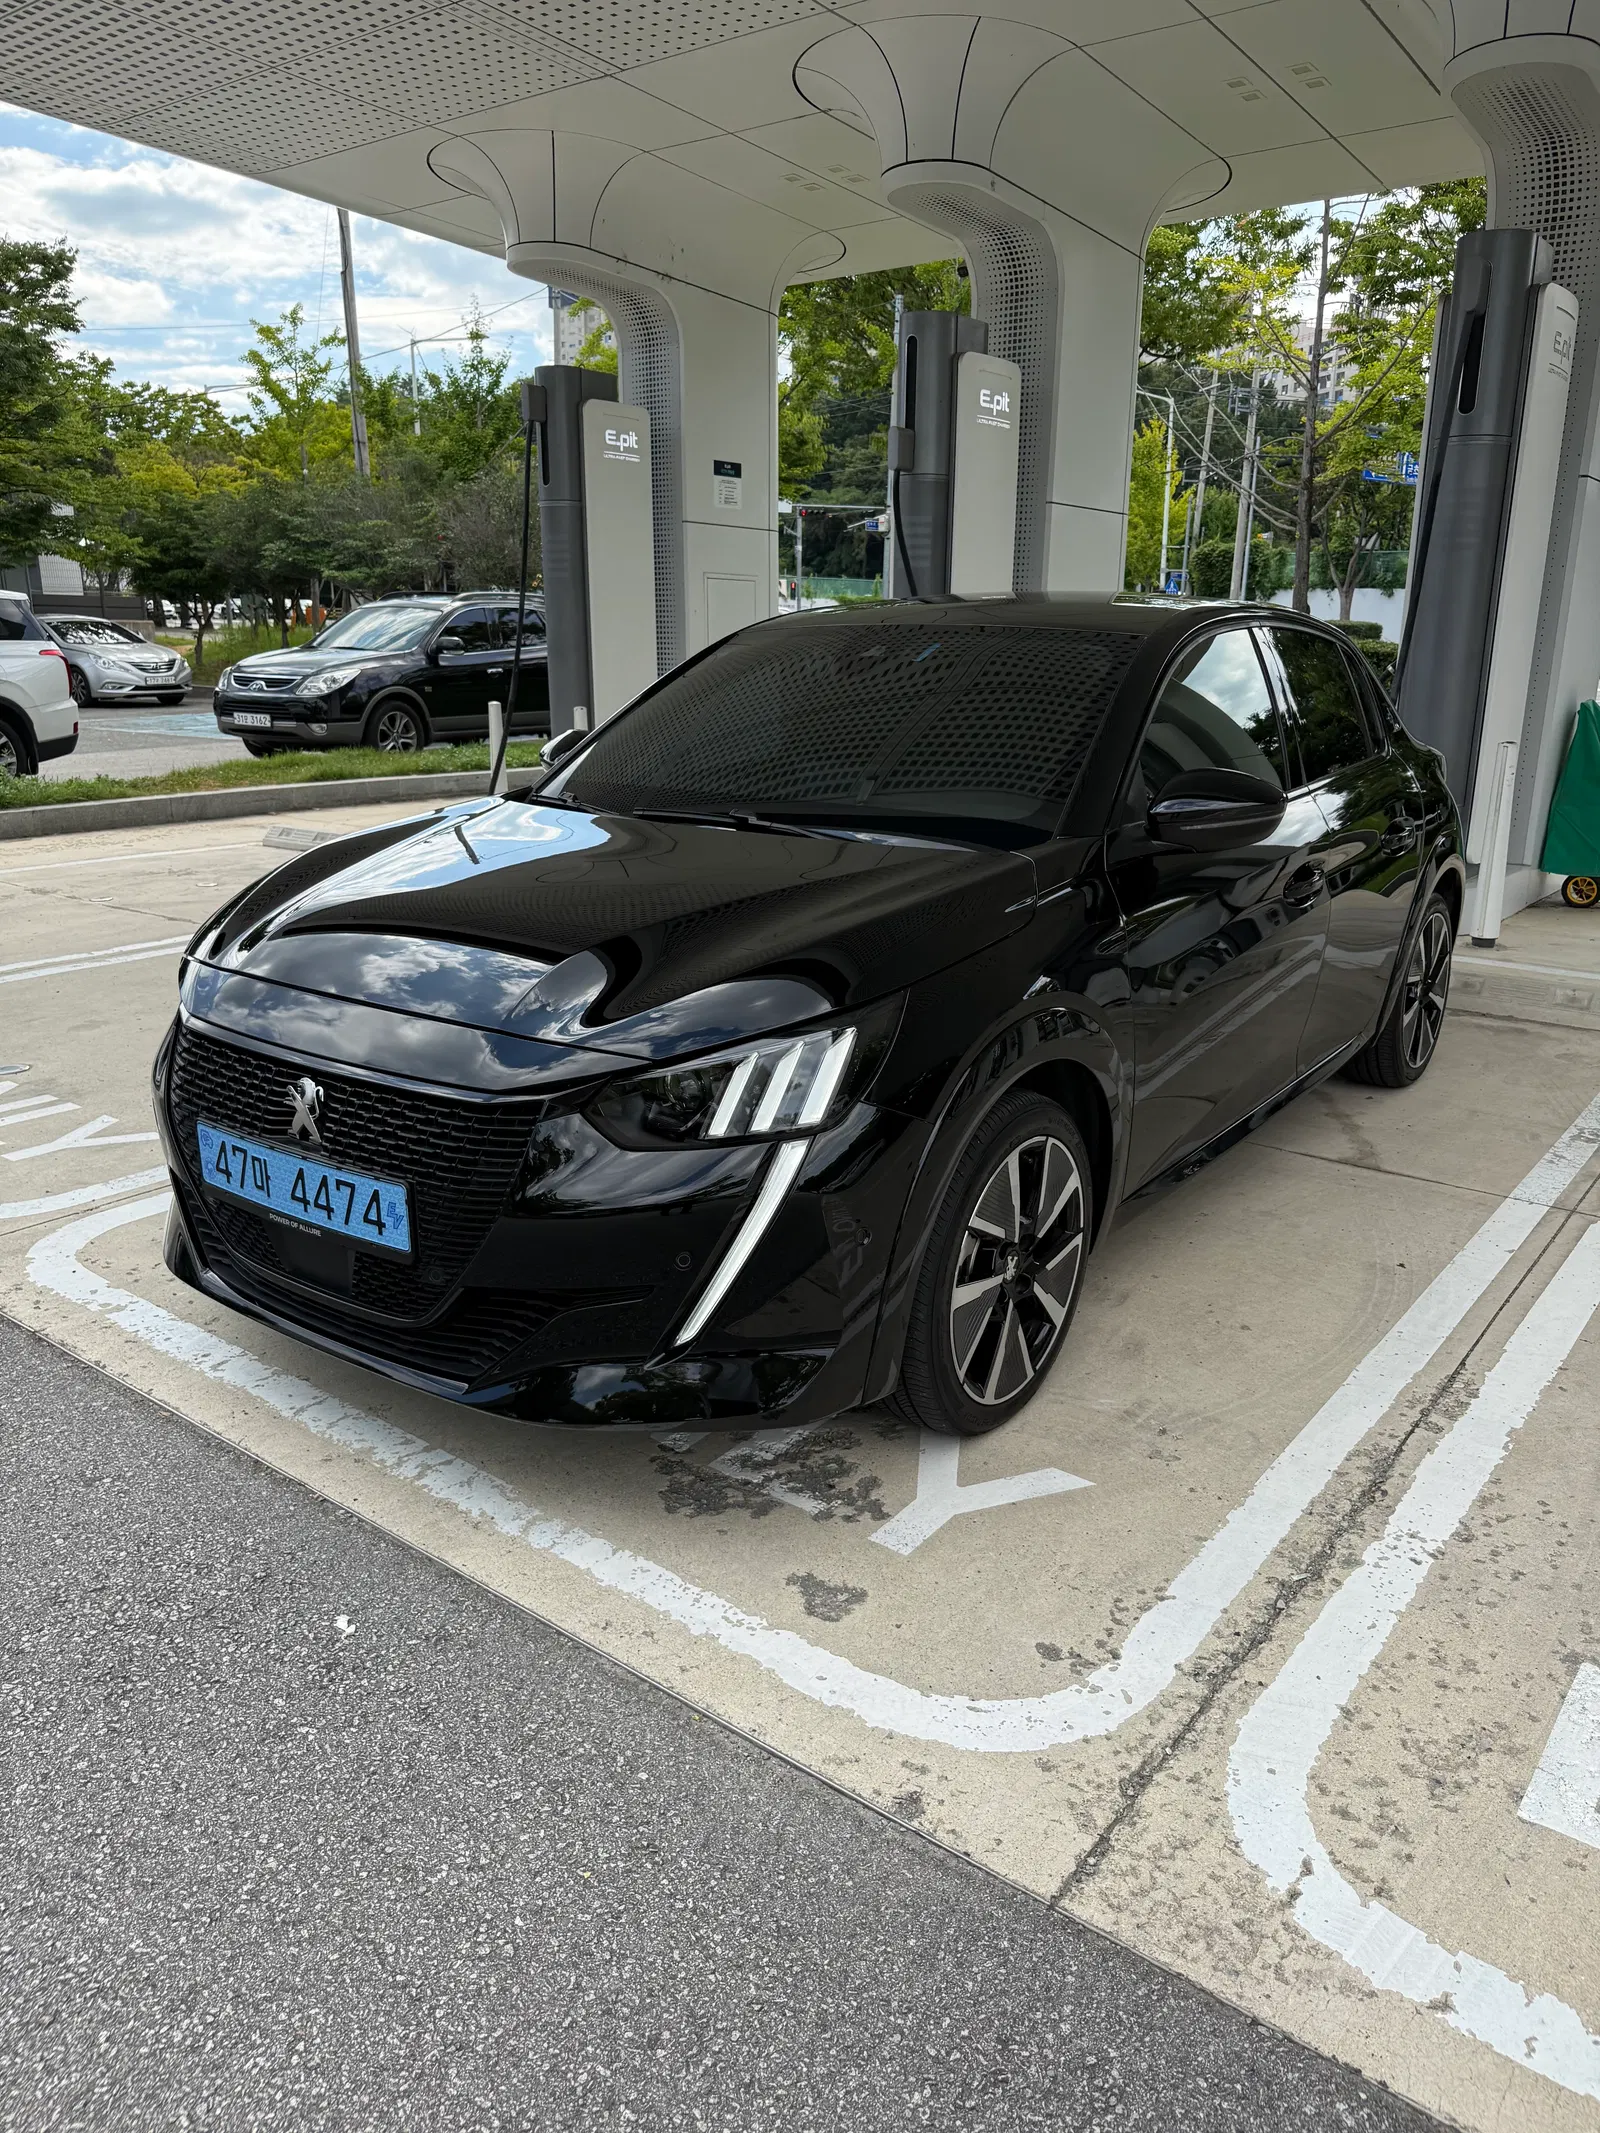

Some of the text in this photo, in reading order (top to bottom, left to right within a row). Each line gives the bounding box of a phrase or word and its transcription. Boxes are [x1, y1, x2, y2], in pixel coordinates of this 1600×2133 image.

[216, 1141, 386, 1235] 47마 4474
[269, 1213, 322, 1237] POWER OF ALLURE
[387, 1202, 404, 1230] EV
